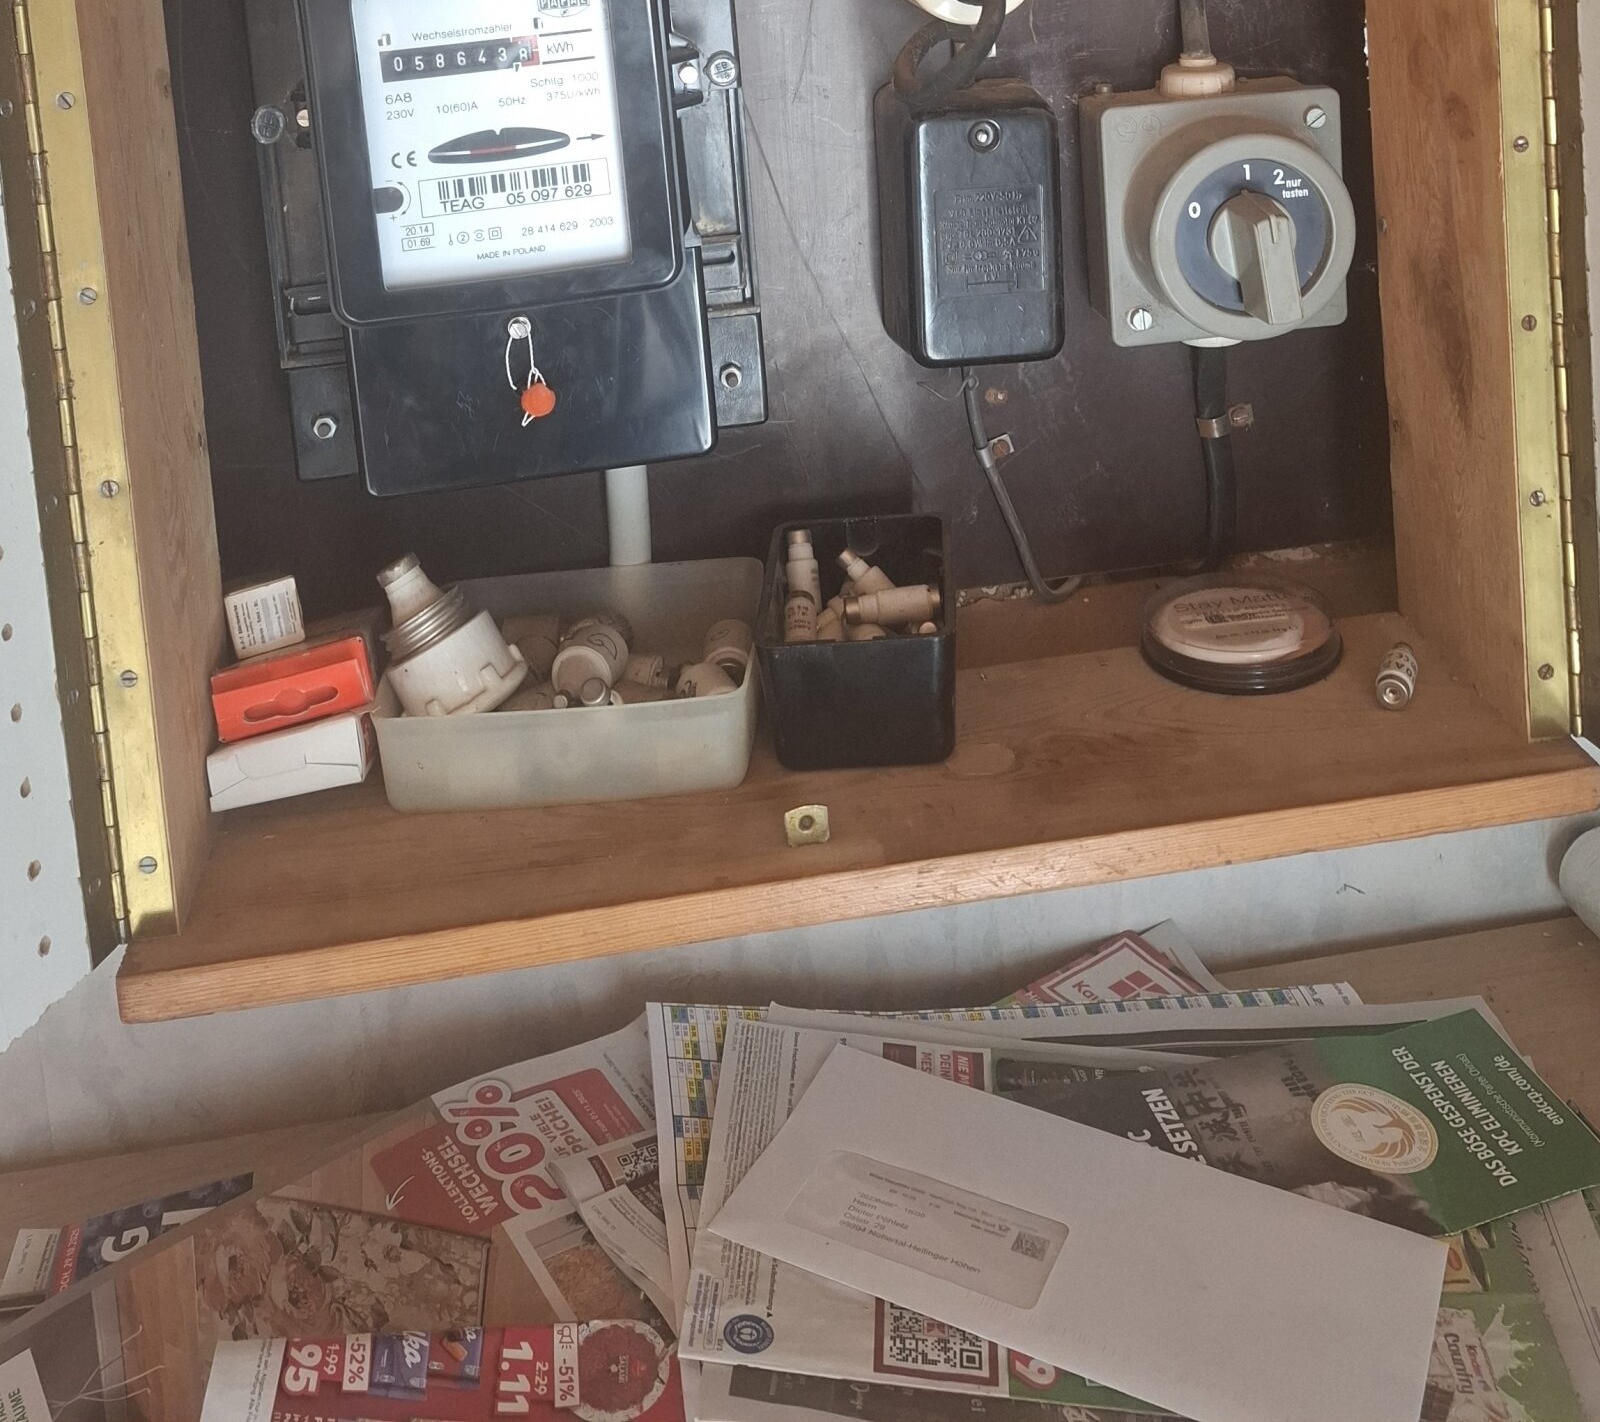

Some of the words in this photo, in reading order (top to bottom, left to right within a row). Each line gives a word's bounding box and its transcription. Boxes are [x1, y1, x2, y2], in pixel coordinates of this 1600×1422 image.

[411, 22, 513, 42] Wechselstromzähler
[546, 41, 575, 56] kWh
[384, 92, 413, 105] 6A8
[386, 108, 416, 121] 230V
[436, 100, 479, 116] 10(60)A
[498, 95, 527, 108] 50Hz
[1242, 163, 1252, 181] 1
[1272, 168, 1286, 186] 2
[1285, 177, 1302, 188] nur
[439, 196, 486, 214] TEAG
[506, 191, 527, 206] 05
[531, 187, 558, 203] 097
[564, 183, 593, 198] 629
[1281, 187, 1309, 199] tasten
[1188, 201, 1202, 219] 0
[521, 226, 535, 238] 28
[537, 223, 556, 235] 414
[559, 220, 579, 232] 629
[476, 250, 501, 261] MADE
[512, 244, 547, 257] POLAND
[1391, 1046, 1421, 1072] DER
[1409, 1071, 1467, 1129] GESPENST
[1430, 1059, 1502, 1132] ELIMINIEREN
[1492, 1054, 1565, 1127] endccp.com/de
[529, 1113, 555, 1145] VIELE
[1140, 1087, 1198, 1154] SETZEN
[447, 1084, 568, 1211] 20%
[1457, 1128, 1496, 1162] BÖSE
[1490, 1129, 1524, 1157] KPC
[421, 1146, 480, 1224] KOLLEKTIONS-
[436, 1135, 499, 1217] WECHSEL
[1485, 1158, 1519, 1188] DAS
[324, 1343, 341, 1376] 1.99
[346, 1336, 370, 1389] -52%
[1443, 1332, 1475, 1395] Country
[496, 1340, 535, 1415] 1.11
[533, 1360, 549, 1396] 2.29
[557, 1356, 579, 1403] -51%
